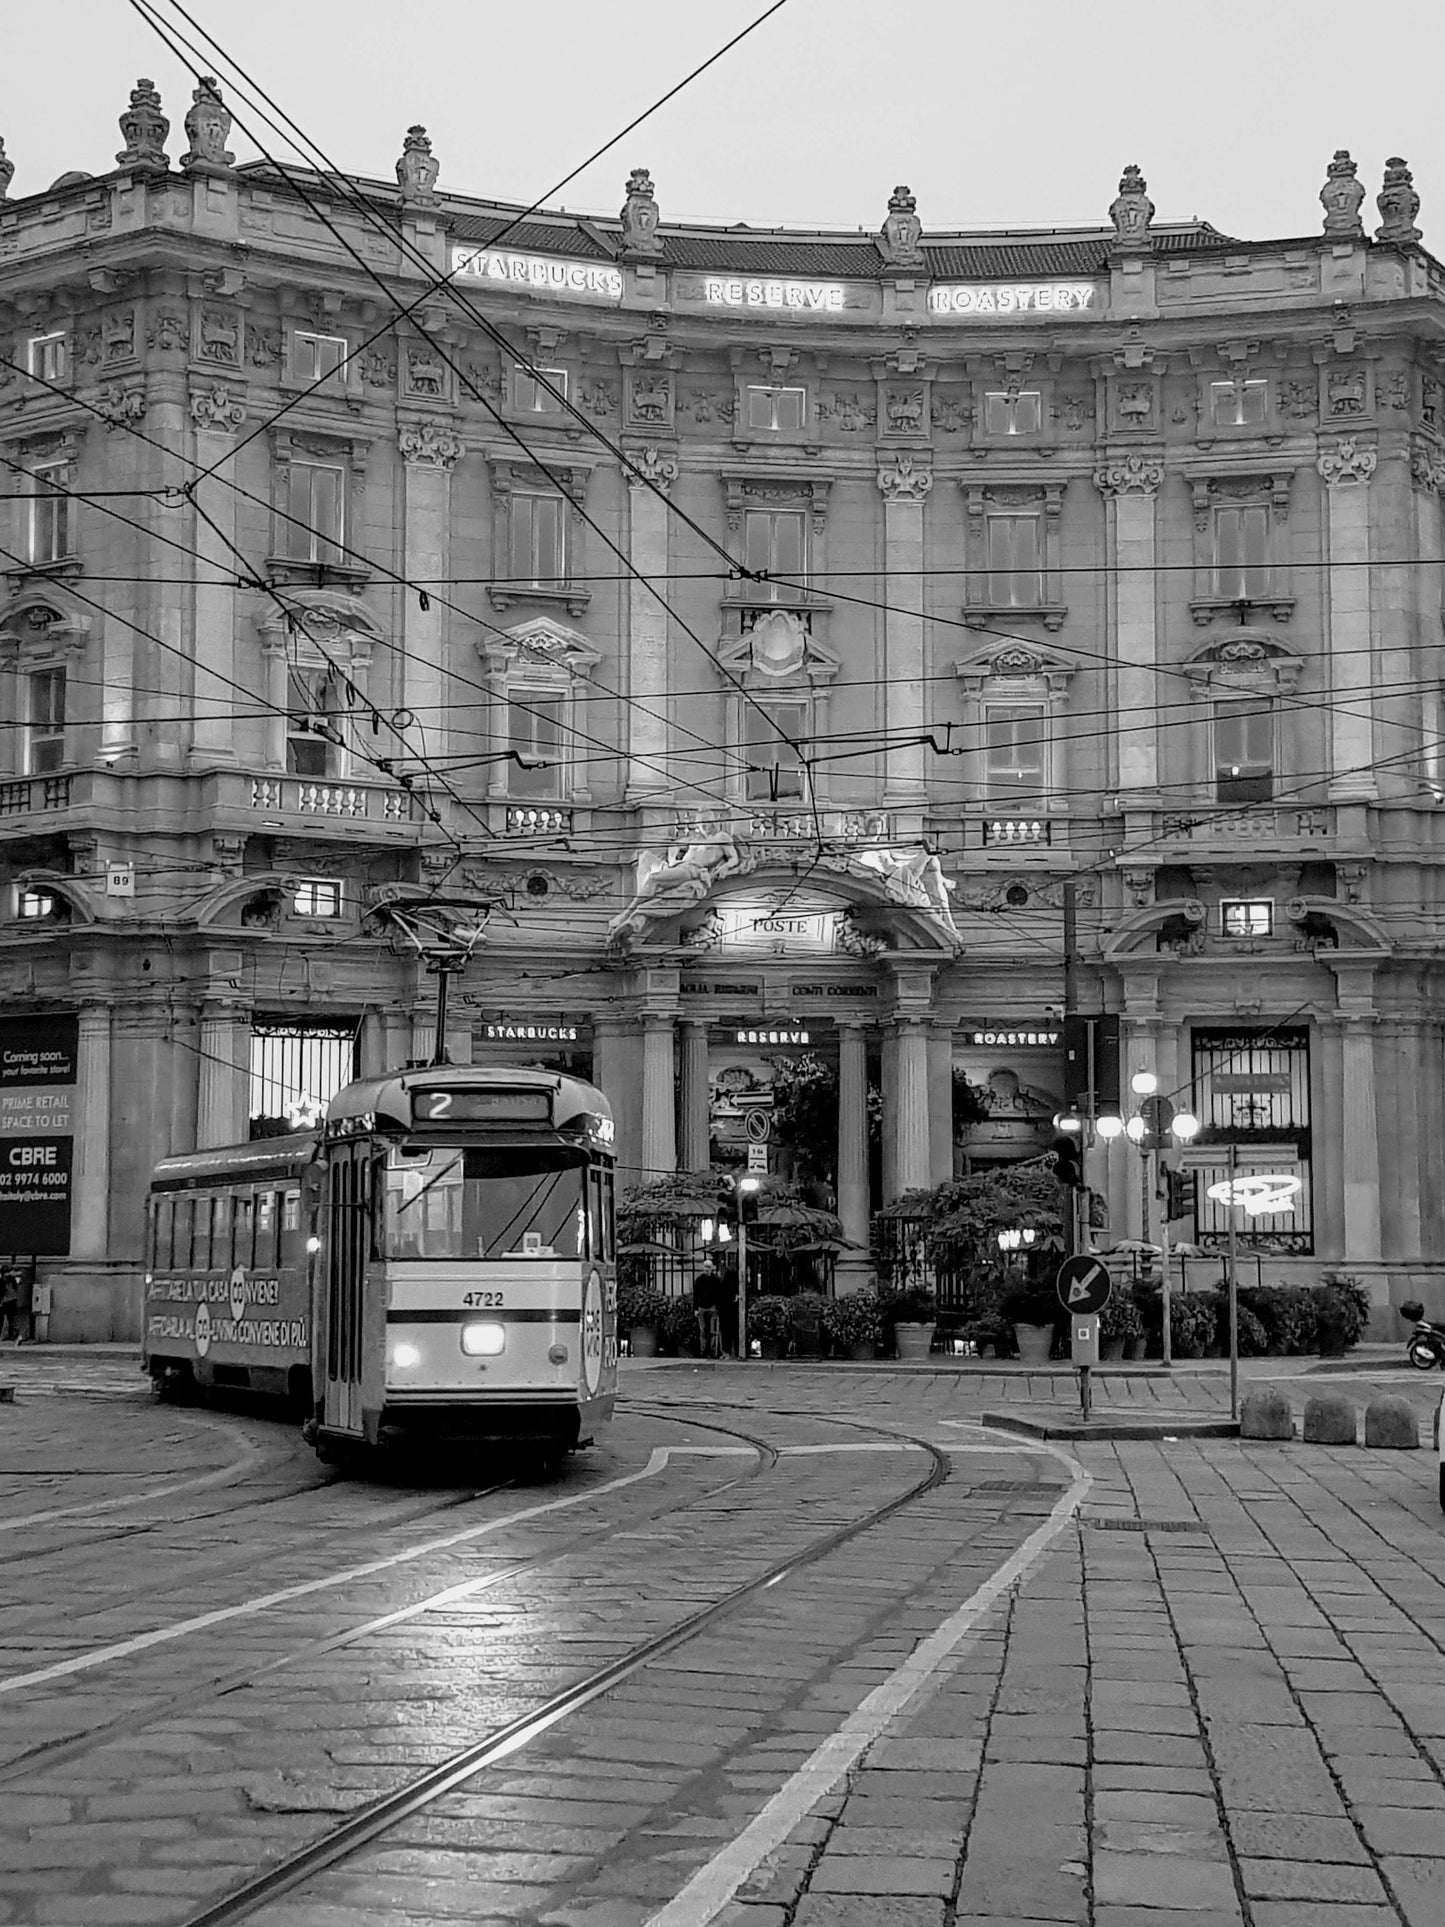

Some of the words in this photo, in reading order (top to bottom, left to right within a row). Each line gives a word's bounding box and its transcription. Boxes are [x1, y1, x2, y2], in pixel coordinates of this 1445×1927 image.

[456, 249, 622, 294] STARBUCKS
[706, 281, 842, 308] RESERVE
[932, 286, 1093, 311] ROASTERY
[113, 875, 129, 886] 89
[753, 918, 808, 934] POSTE
[487, 1025, 577, 1040] STARBUCKS
[737, 1030, 809, 1044] RESERVE
[974, 1032, 1058, 1045] ROASTERY
[3, 1050, 38, 1065] Coming
[2, 1067, 19, 1078] your
[2, 1097, 33, 1110] PRIME
[36, 1095, 70, 1109] RETAIL
[428, 1092, 453, 1120] 2
[1, 1115, 33, 1129] SPACE
[35, 1115, 50, 1127] TO
[52, 1114, 70, 1127] LET
[9, 1146, 58, 1166] CBRE
[0, 1173, 12, 1186] 02
[14, 1172, 40, 1186] 9974
[42, 1172, 68, 1185] 6000
[463, 1291, 504, 1307] 4722
[238, 1319, 280, 1346] CONVIENE
